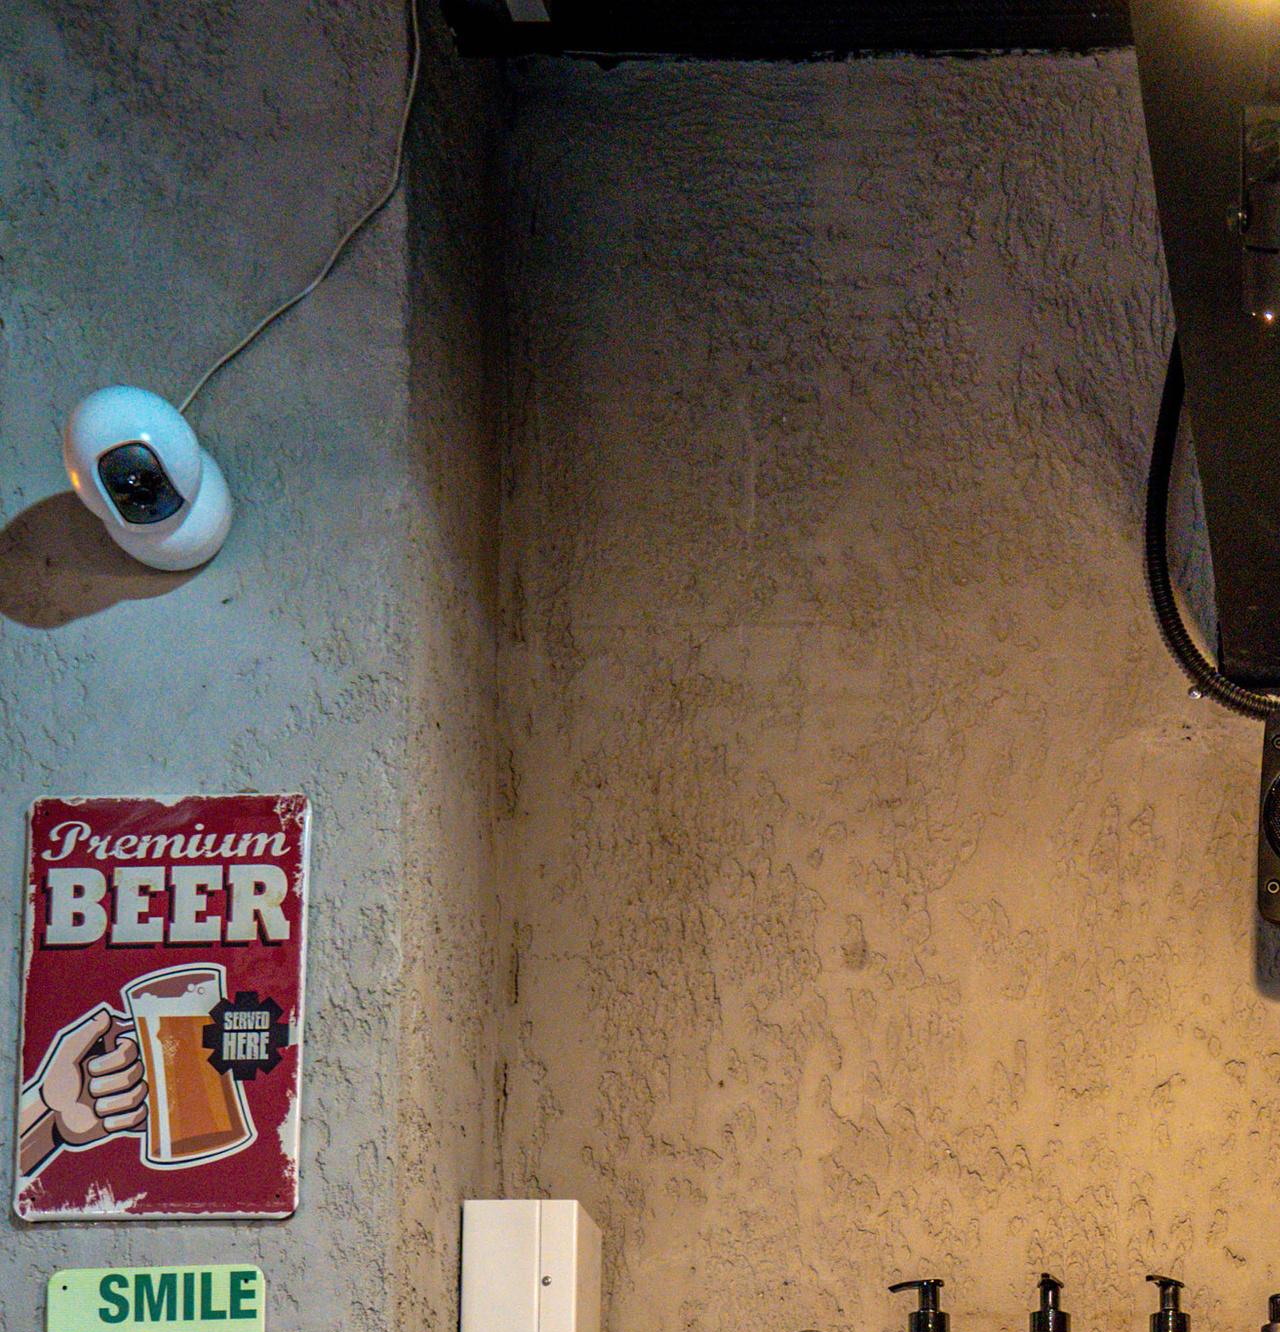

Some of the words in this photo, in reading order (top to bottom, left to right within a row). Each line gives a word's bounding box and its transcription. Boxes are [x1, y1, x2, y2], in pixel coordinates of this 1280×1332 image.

[42, 821, 291, 862] Premium
[42, 865, 291, 948] BEER
[224, 1010, 270, 1030] SERVED
[223, 1032, 270, 1061] HERE
[99, 1271, 257, 1324] SMILE
